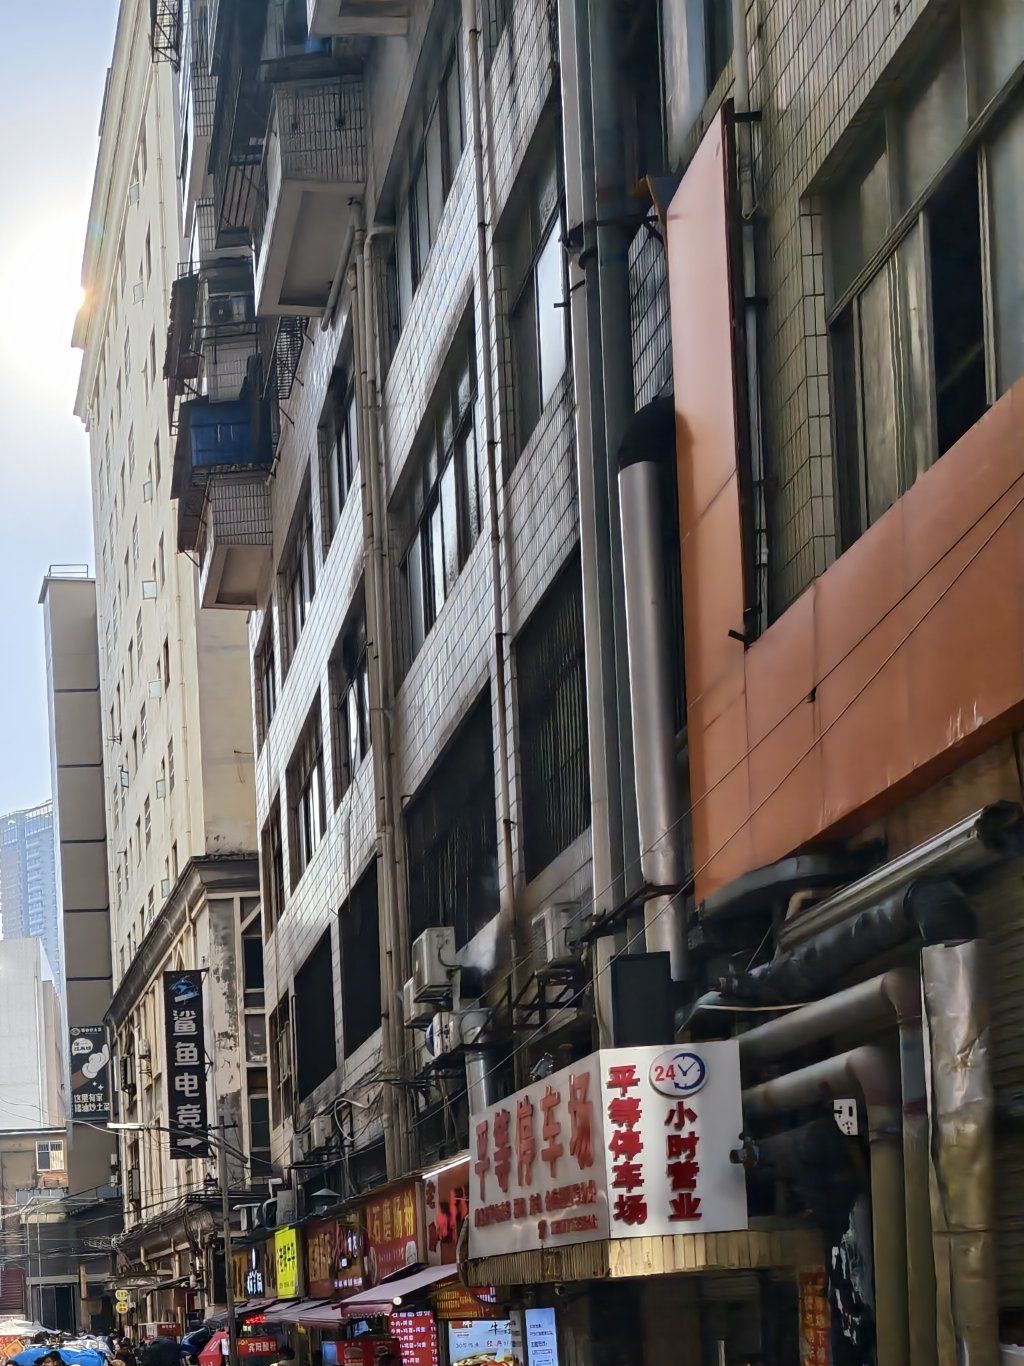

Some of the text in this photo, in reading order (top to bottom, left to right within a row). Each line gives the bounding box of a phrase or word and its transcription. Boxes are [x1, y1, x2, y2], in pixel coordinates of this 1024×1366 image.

[172, 1009, 203, 1129] 鲨鱼电竞
[654, 1064, 676, 1081] 24
[475, 1072, 594, 1203] 平等停车场
[606, 1064, 648, 1225] 平等停车场
[663, 1101, 703, 1222] 小时营业
